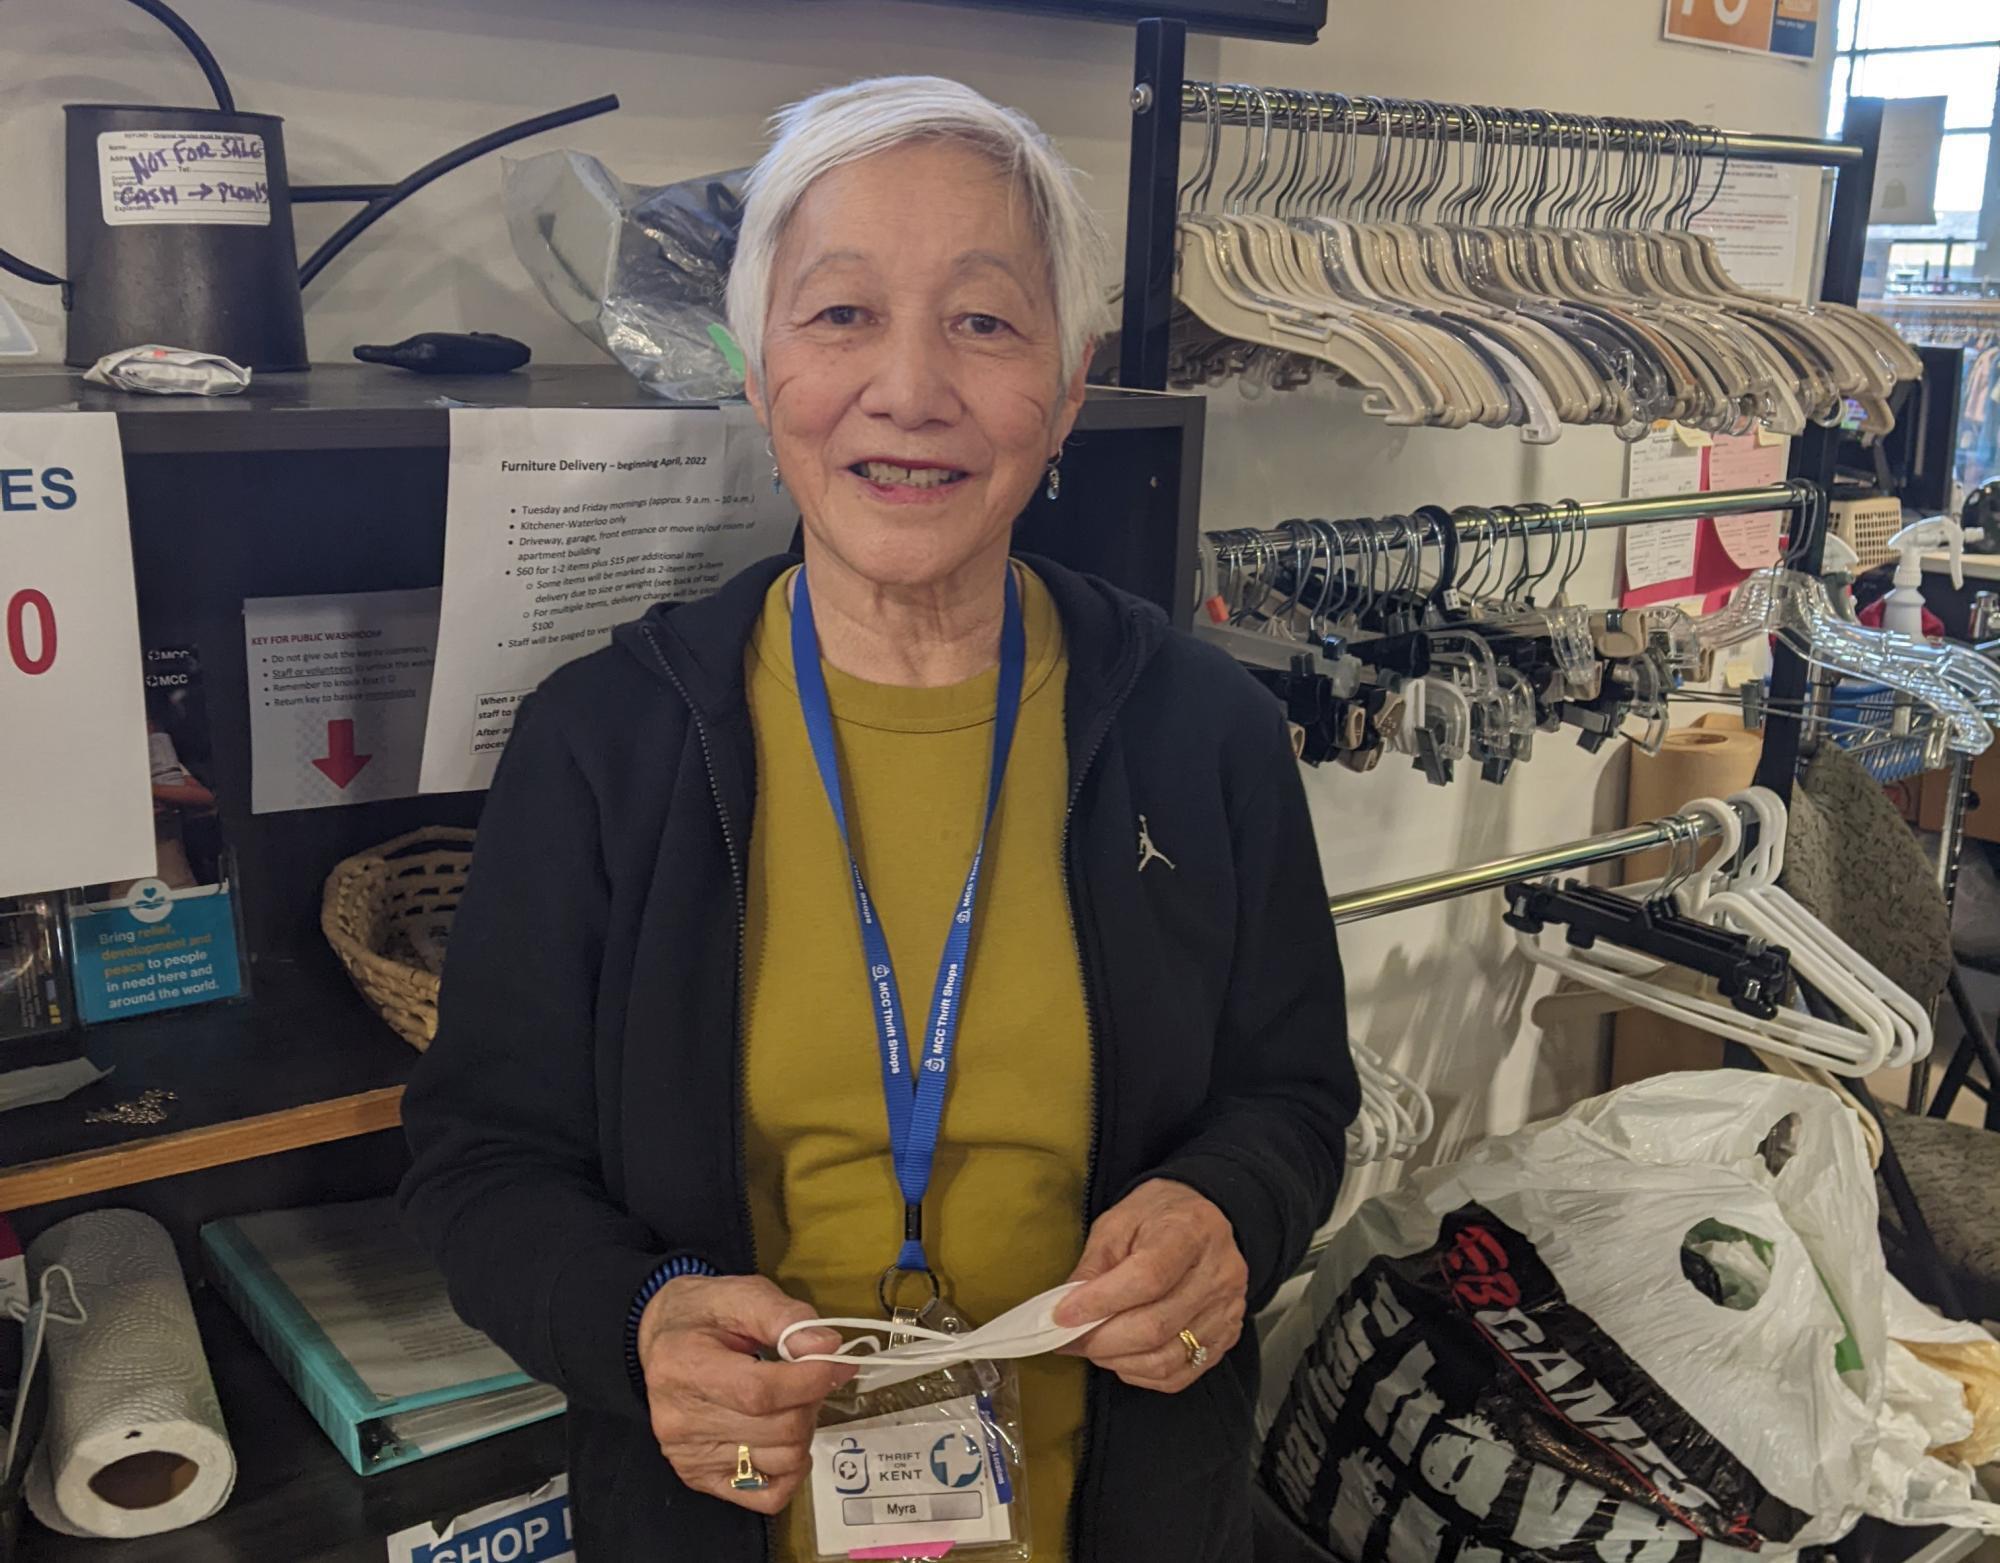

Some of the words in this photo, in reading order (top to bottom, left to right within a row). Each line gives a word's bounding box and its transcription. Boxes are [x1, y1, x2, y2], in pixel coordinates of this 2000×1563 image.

[129, 149, 169, 185] NOT
[173, 138, 217, 165] FOR
[221, 137, 263, 160] SALE
[120, 185, 178, 206] CASH
[502, 460, 557, 472] Furniture
[559, 460, 607, 473] Delivery
[617, 459, 658, 471] beginning
[660, 457, 682, 468] April,
[685, 457, 707, 465] 2022
[0, 467, 77, 511] ES
[522, 505, 560, 515] Tuesday
[563, 505, 579, 514] and
[582, 503, 608, 512] Friday
[610, 500, 647, 509] mornings
[685, 496, 692, 504] 9
[520, 518, 607, 530] Kitchener-Waterloo
[609, 516, 626, 525] only
[520, 537, 564, 546] Driveway,
[600, 530, 620, 540] front
[621, 526, 656, 537] entrance
[516, 566, 534, 576] $60
[536, 566, 550, 575] for
[552, 564, 565, 574] 1-2
[567, 562, 590, 571] items
[592, 560, 608, 570] plus
[610, 556, 624, 566] $15
[626, 556, 640, 564] per
[641, 552, 684, 560] additional
[518, 551, 566, 562] apartment
[568, 546, 600, 558] building
[536, 580, 561, 589] Some
[563, 577, 586, 586] items
[588, 573, 602, 582] will
[603, 572, 612, 580] be
[614, 566, 645, 576] marked
[536, 593, 569, 604] delivery
[571, 590, 586, 598] due
[588, 588, 597, 596] to
[598, 586, 612, 594] size
[654, 578, 671, 588] (see
[534, 609, 548, 618] For
[550, 604, 583, 615] multiple
[611, 595, 641, 605] delivery
[642, 592, 671, 601] charge
[532, 621, 554, 632] $100
[252, 636, 268, 645] KEY
[271, 635, 288, 644] FOR
[291, 632, 323, 642] PUBLIC
[325, 630, 382, 640] WASHROOM
[508, 638, 530, 648] Staff
[532, 636, 546, 645] will
[548, 636, 558, 644] be
[560, 630, 585, 642] paged
[161, 650, 190, 659] MCC
[272, 655, 284, 663] Do
[286, 654, 301, 662] not
[304, 653, 320, 662] give
[322, 652, 338, 660] out
[160, 674, 188, 686] MCC
[272, 668, 292, 679] Staff
[306, 666, 352, 676] volunteers
[273, 682, 321, 692] Remember
[322, 680, 332, 688] to
[274, 698, 304, 706] Return
[305, 696, 320, 704] key
[480, 696, 508, 706] When
[478, 710, 500, 719] staff
[476, 728, 500, 736] After
[962, 882, 974, 907] MCC
[860, 891, 872, 924] Shops
[99, 931, 136, 945] Bring
[101, 938, 186, 960] development
[104, 962, 144, 978] peace
[148, 959, 161, 968] to
[164, 950, 208, 968] people
[106, 982, 118, 992] in
[122, 974, 156, 990] need
[158, 970, 188, 983] here
[190, 964, 213, 978] and
[943, 963, 958, 998] Shops
[108, 990, 156, 1009] around
[158, 987, 180, 1000] the
[182, 978, 220, 995] world.
[879, 982, 892, 1008] MCC
[883, 1008, 896, 1038] Thrift
[936, 998, 952, 1028] Thrift
[932, 1028, 946, 1054] MCC
[888, 1039, 901, 1075] Shops
[1474, 1306, 1721, 1511] GAMES
[878, 1451, 921, 1462] THRIFT
[880, 1470, 923, 1482] KENT
[887, 1504, 916, 1516] Myra
